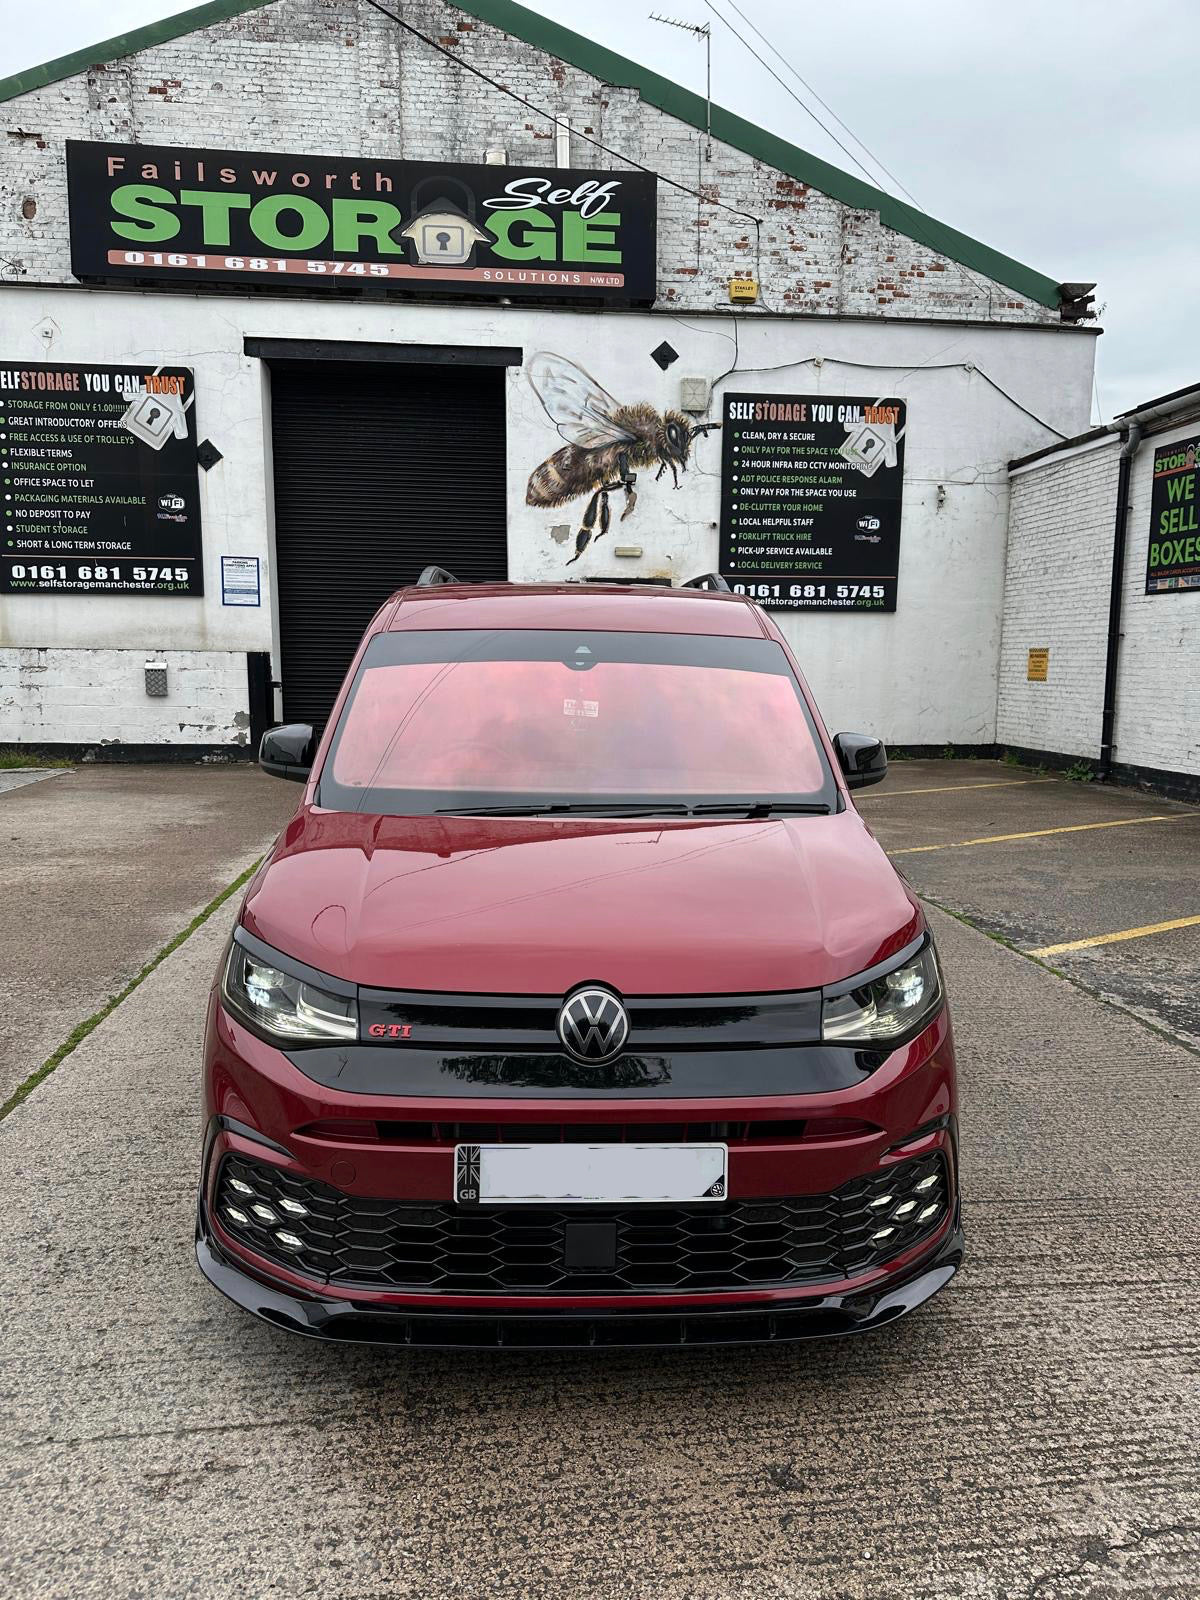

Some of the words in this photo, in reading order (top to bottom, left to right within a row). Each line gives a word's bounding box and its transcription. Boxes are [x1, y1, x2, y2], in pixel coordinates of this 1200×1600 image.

[107, 156, 393, 193] Failsworth
[482, 177, 622, 219] Self
[124, 251, 206, 267] 0161
[224, 258, 287, 271] 681
[307, 262, 389, 276] 5745
[483, 270, 581, 283] SOLUTIONS
[606, 276, 620, 285] LTD
[0, 370, 80, 391] ELFSTORAGE
[84, 373, 110, 392] YOU
[114, 374, 140, 393] CAN
[144, 375, 185, 394] TRUST
[8, 400, 44, 410] STORAGE
[46, 402, 68, 410] FROM
[70, 402, 90, 410] ONLY
[811, 404, 834, 422] YOU
[838, 406, 860, 423] CAN
[864, 406, 900, 424] TRUST
[8, 416, 33, 426] GREAT
[35, 418, 96, 427] INTRODUCTORY
[98, 420, 127, 428] OFFERS
[10, 432, 28, 440] FREE
[30, 434, 58, 442] ACCESS
[84, 435, 96, 443] OF
[96, 436, 134, 444] TROLLEYS
[742, 432, 766, 440] CLEAN,
[768, 432, 782, 440] DRY
[10, 448, 46, 456] FLEXIBLE
[46, 449, 72, 458] TERMS
[12, 462, 55, 470] INSURANCE
[56, 463, 87, 471] OPTION
[742, 460, 750, 468] 24
[772, 460, 792, 468] INFRA
[828, 462, 872, 470] MONITORING
[14, 478, 40, 486] OFFICE
[42, 478, 66, 487] SPACE
[68, 480, 78, 488] TO
[80, 480, 94, 488] LET
[756, 475, 780, 483] POLICE
[1168, 474, 1195, 503] WE
[14, 494, 60, 502] PACKAGING
[61, 495, 104, 504] MATERIALS
[105, 496, 146, 504] AVAILABLE
[740, 503, 780, 511] DE-CLUTTER
[803, 504, 824, 512] HOME
[16, 510, 27, 518] NO
[29, 510, 61, 518] DEPOSIT
[62, 510, 74, 518] TO
[1160, 505, 1198, 535] SELL
[16, 524, 50, 533] STUDENT
[52, 526, 88, 534] STORAGE
[16, 540, 42, 548] SHORT
[52, 541, 72, 549] LONG
[74, 541, 96, 550] TERM
[96, 542, 132, 550] STORAGE
[12, 565, 67, 580] 0161
[78, 566, 120, 580] 681
[132, 567, 188, 581] 5745
[10, 580, 190, 590] www.selfstoragemanchester.org.uk
[734, 584, 780, 596] 0161
[790, 584, 826, 598] 681
[836, 586, 884, 598] 5745
[368, 1023, 413, 1038] GTI
[460, 1189, 477, 1199] GB
